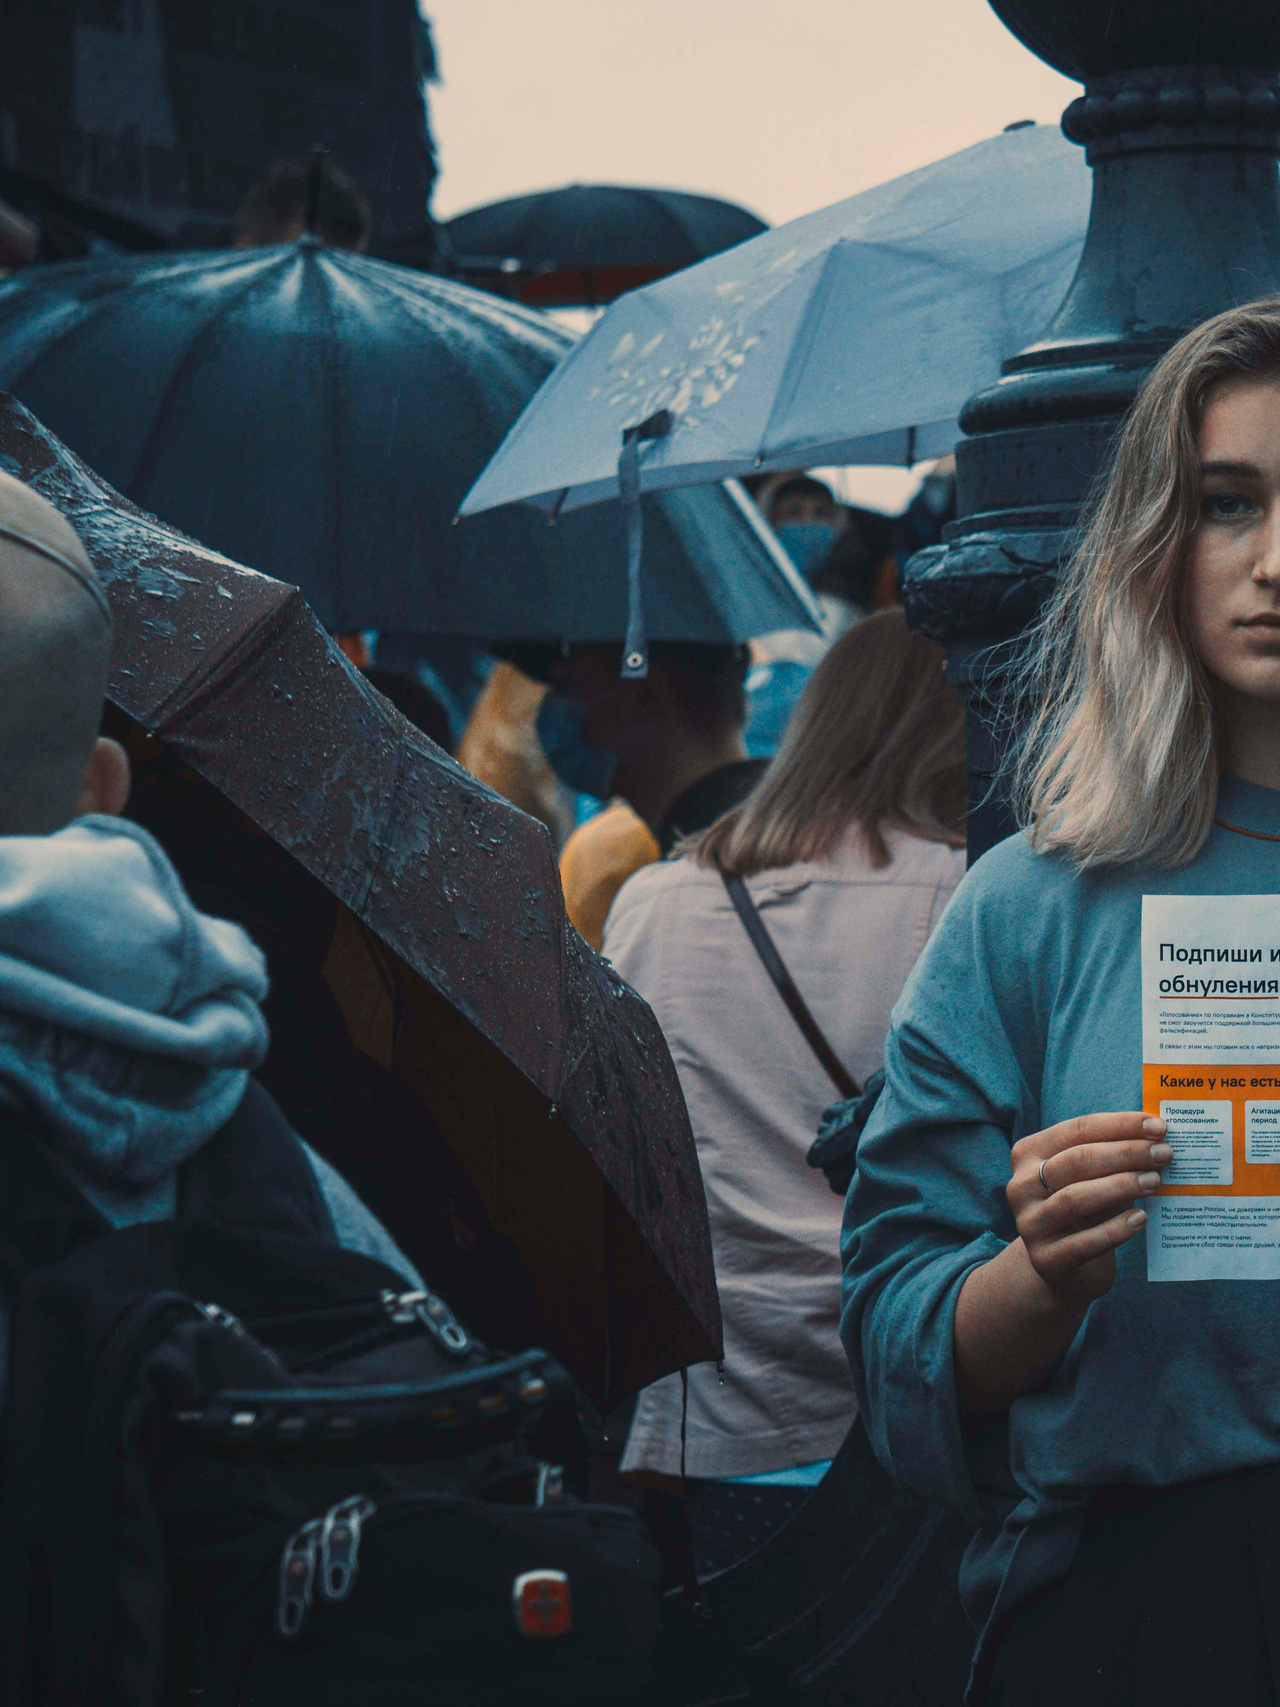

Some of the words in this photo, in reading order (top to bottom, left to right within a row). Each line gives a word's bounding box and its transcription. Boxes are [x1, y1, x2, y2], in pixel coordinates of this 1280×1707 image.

[1159, 943, 1262, 966] Подпиши
[1159, 976, 1279, 997] обнуления
[1160, 1074, 1204, 1088] Какие
[1208, 1078, 1216, 1091] у
[1221, 1076, 1246, 1088] нас
